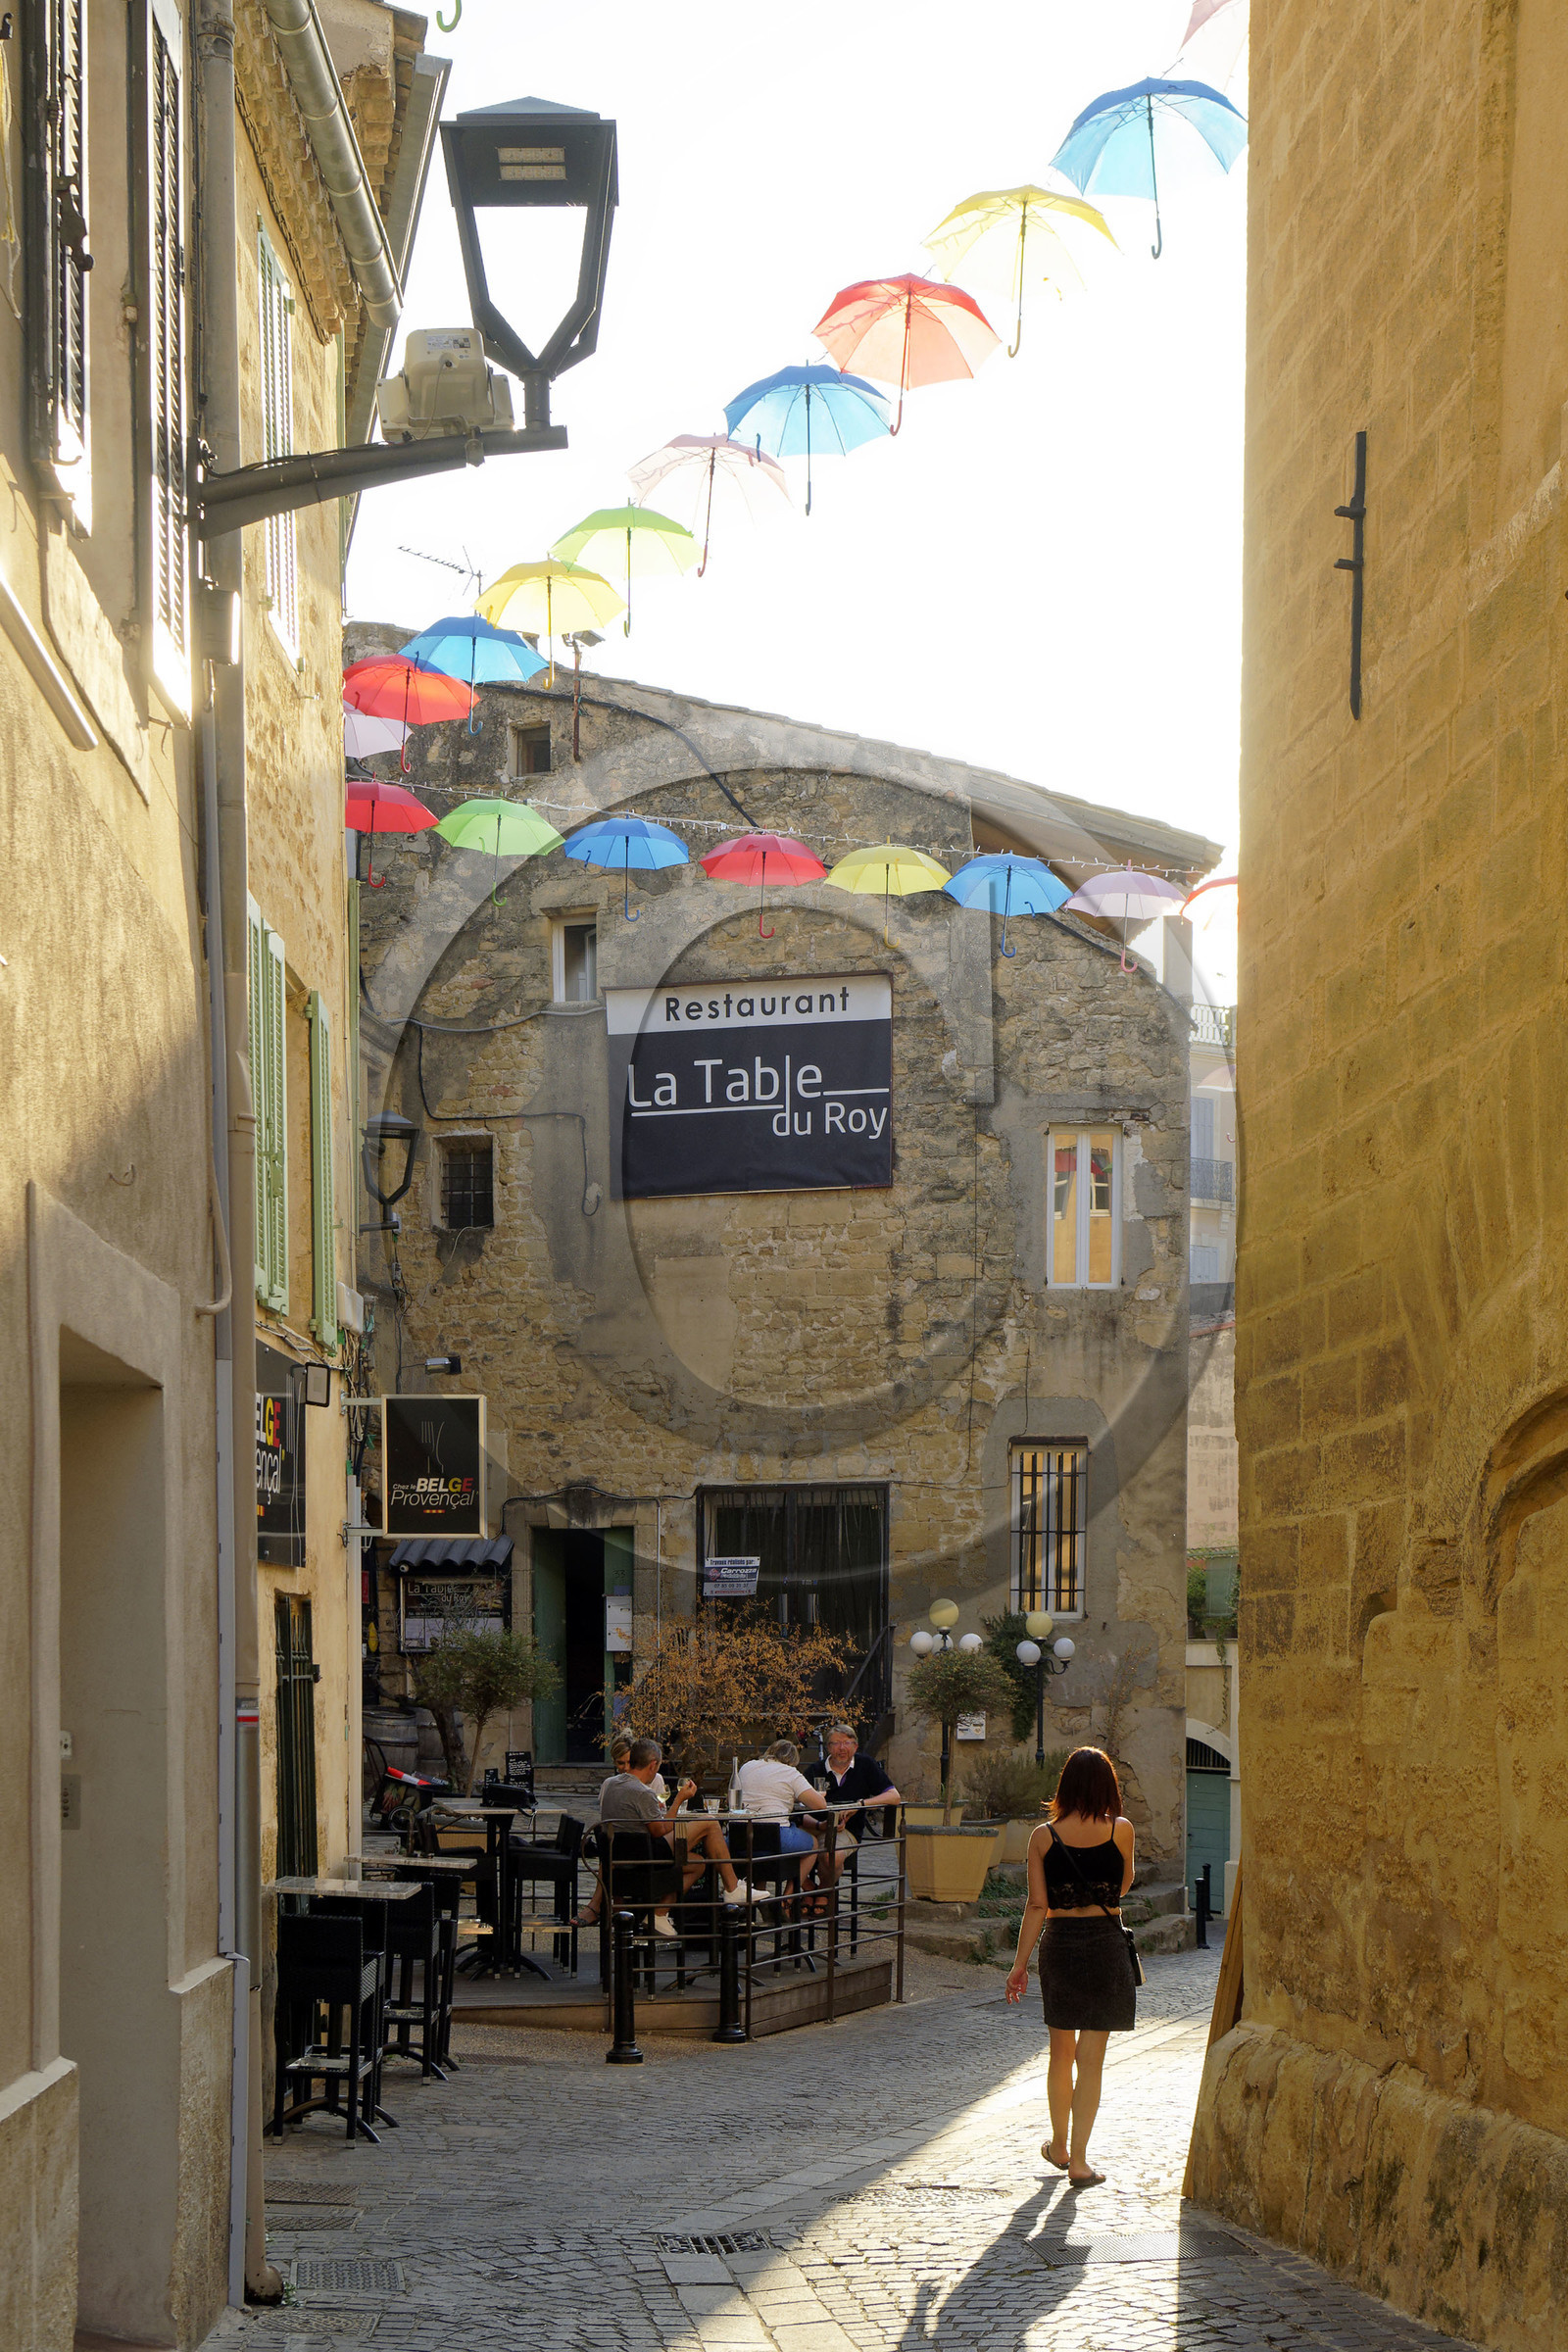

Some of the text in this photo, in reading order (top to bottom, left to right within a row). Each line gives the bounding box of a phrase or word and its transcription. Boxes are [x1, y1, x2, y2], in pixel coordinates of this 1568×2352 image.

[664, 986, 850, 1021] Restaurant
[628, 1054, 822, 1107] La Table
[772, 1102, 888, 1140] du Roy
[256, 1393, 281, 1447] ELGE
[416, 1478, 473, 1493] BELGE
[407, 1582, 420, 1593] La
